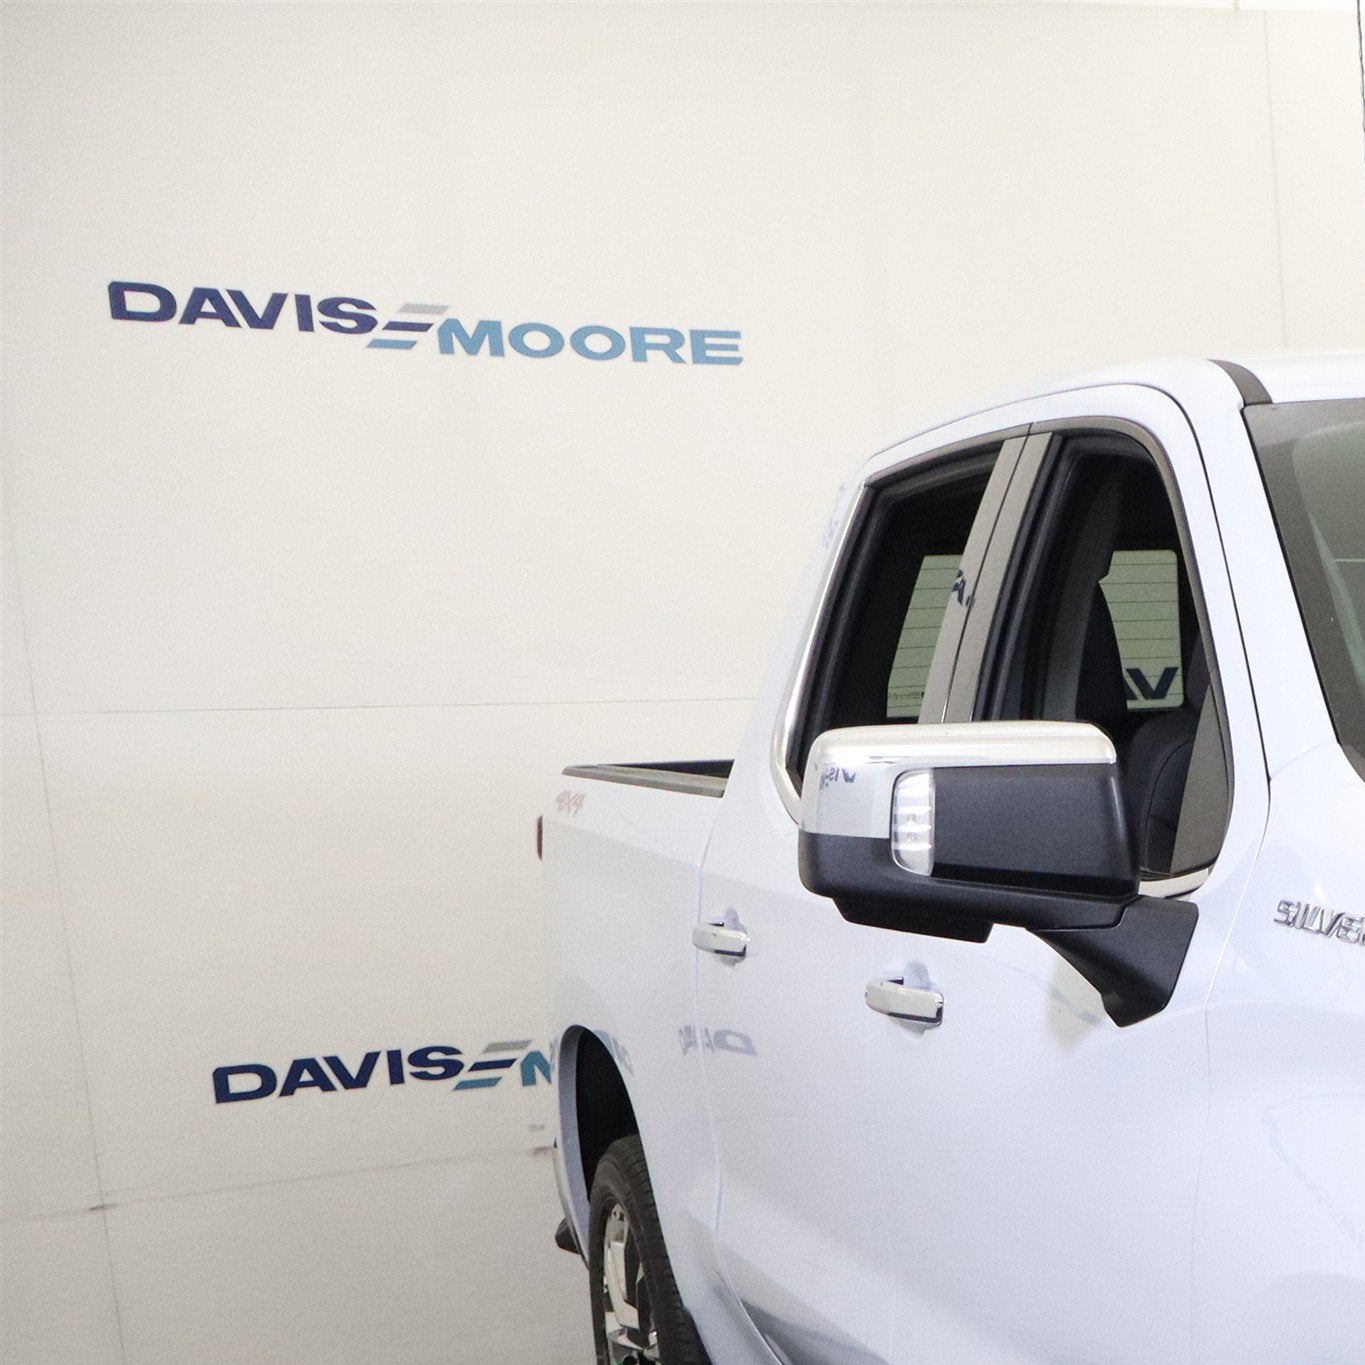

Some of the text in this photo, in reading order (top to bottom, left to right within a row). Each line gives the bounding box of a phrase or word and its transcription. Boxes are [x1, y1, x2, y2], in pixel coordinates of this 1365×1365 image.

[106, 279, 745, 366] DAVIS MOORE
[211, 1044, 467, 1105] DAVIS
